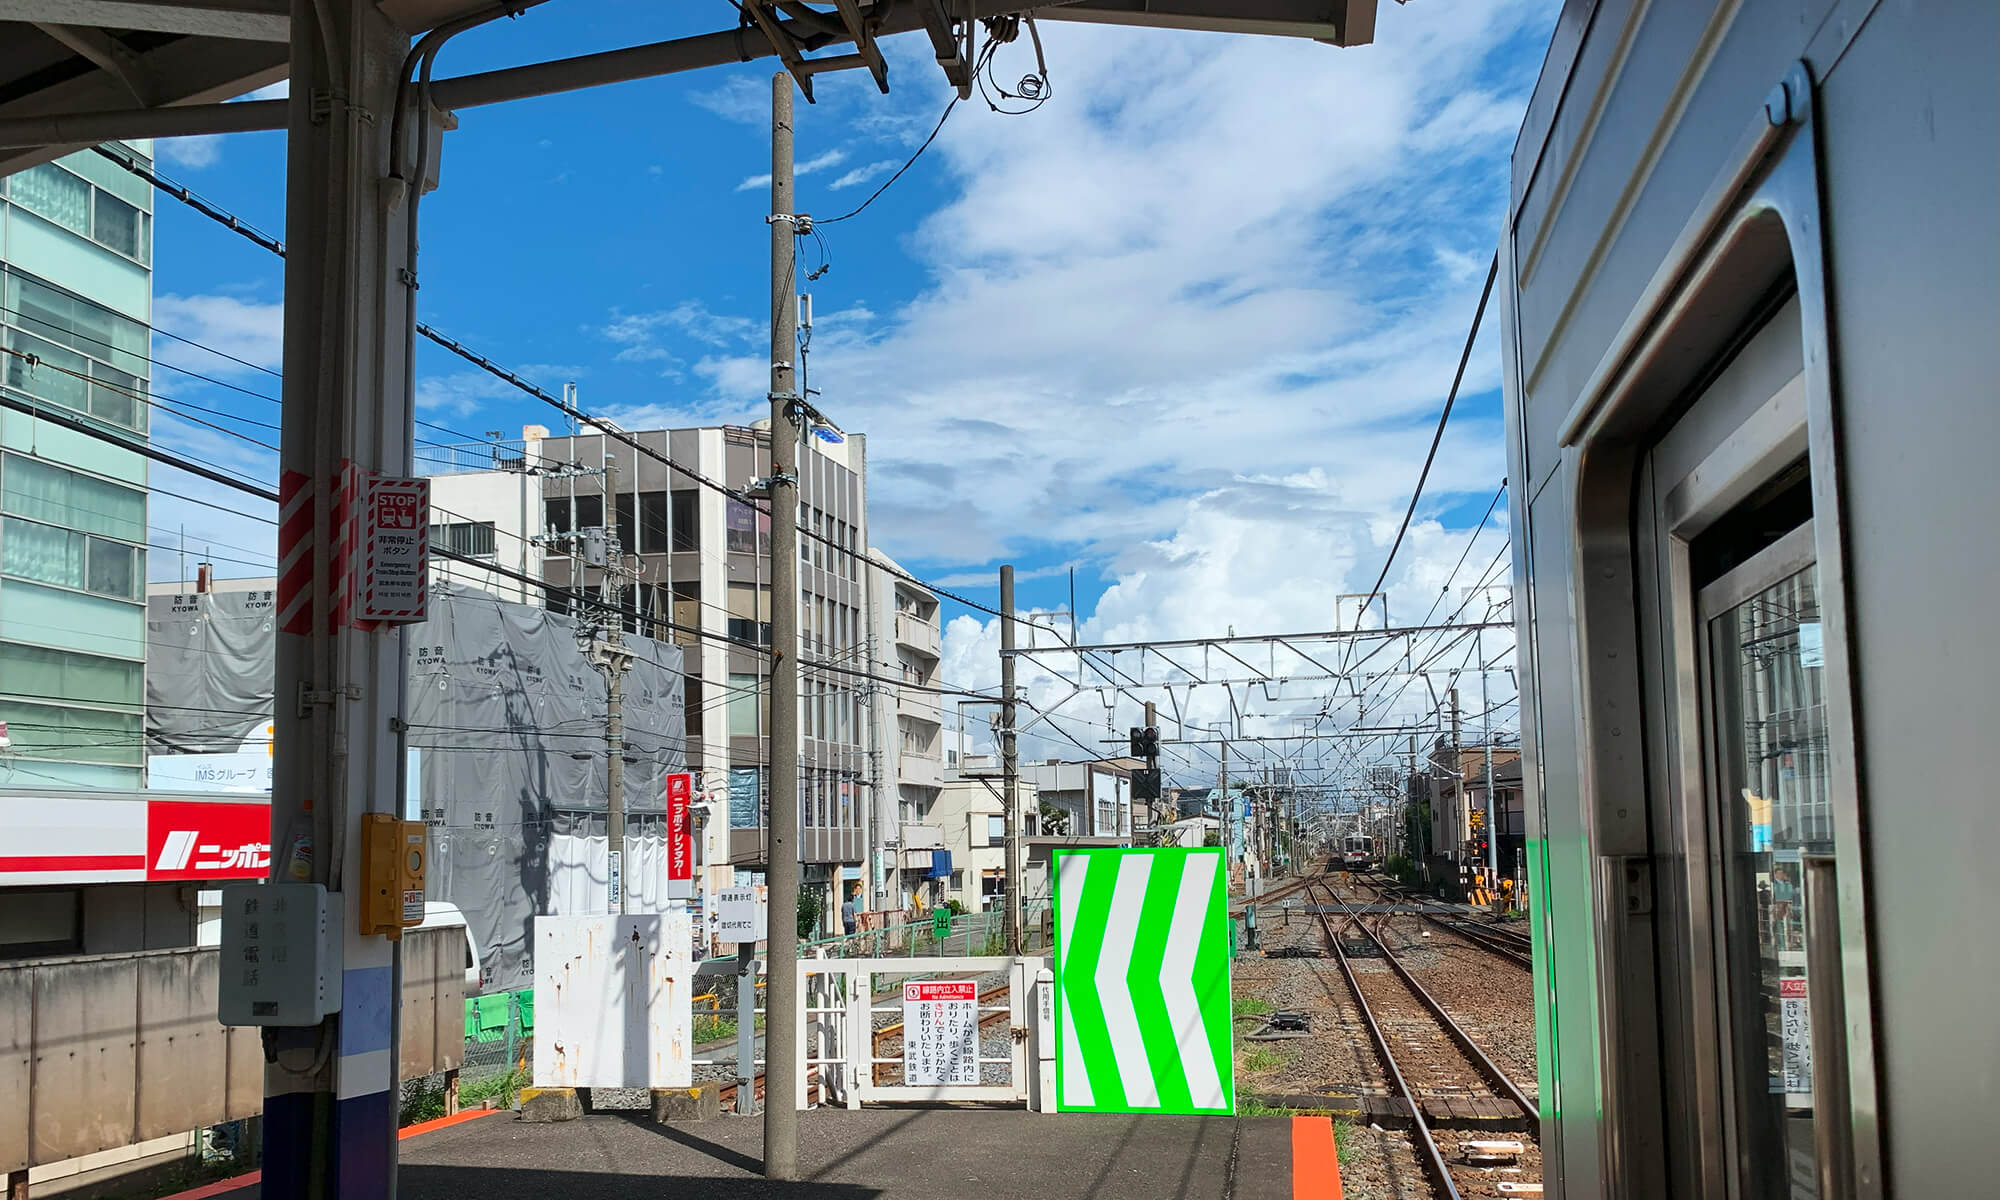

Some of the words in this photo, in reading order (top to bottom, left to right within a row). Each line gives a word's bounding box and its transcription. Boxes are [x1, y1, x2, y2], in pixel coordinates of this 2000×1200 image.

[379, 495, 416, 506] STOP
[378, 536, 415, 545] 非常停止
[383, 546, 410, 556] ボタン
[416, 657, 446, 666] KYOWA
[195, 769, 257, 781] IMSグループ
[672, 797, 685, 877] ニッポンレンタカー
[936, 917, 947, 929] 出
[243, 898, 260, 987] 鉄道電話
[922, 985, 974, 995] 線路内立入禁止
[920, 1002, 932, 1078] お断わりいたします。
[934, 1002, 946, 1083] きけんですからかたく
[948, 1002, 960, 1083] おりたり、歩くことは
[962, 1002, 975, 1083] ホームから線路内に
[908, 1041, 917, 1083] 東武鉄道
